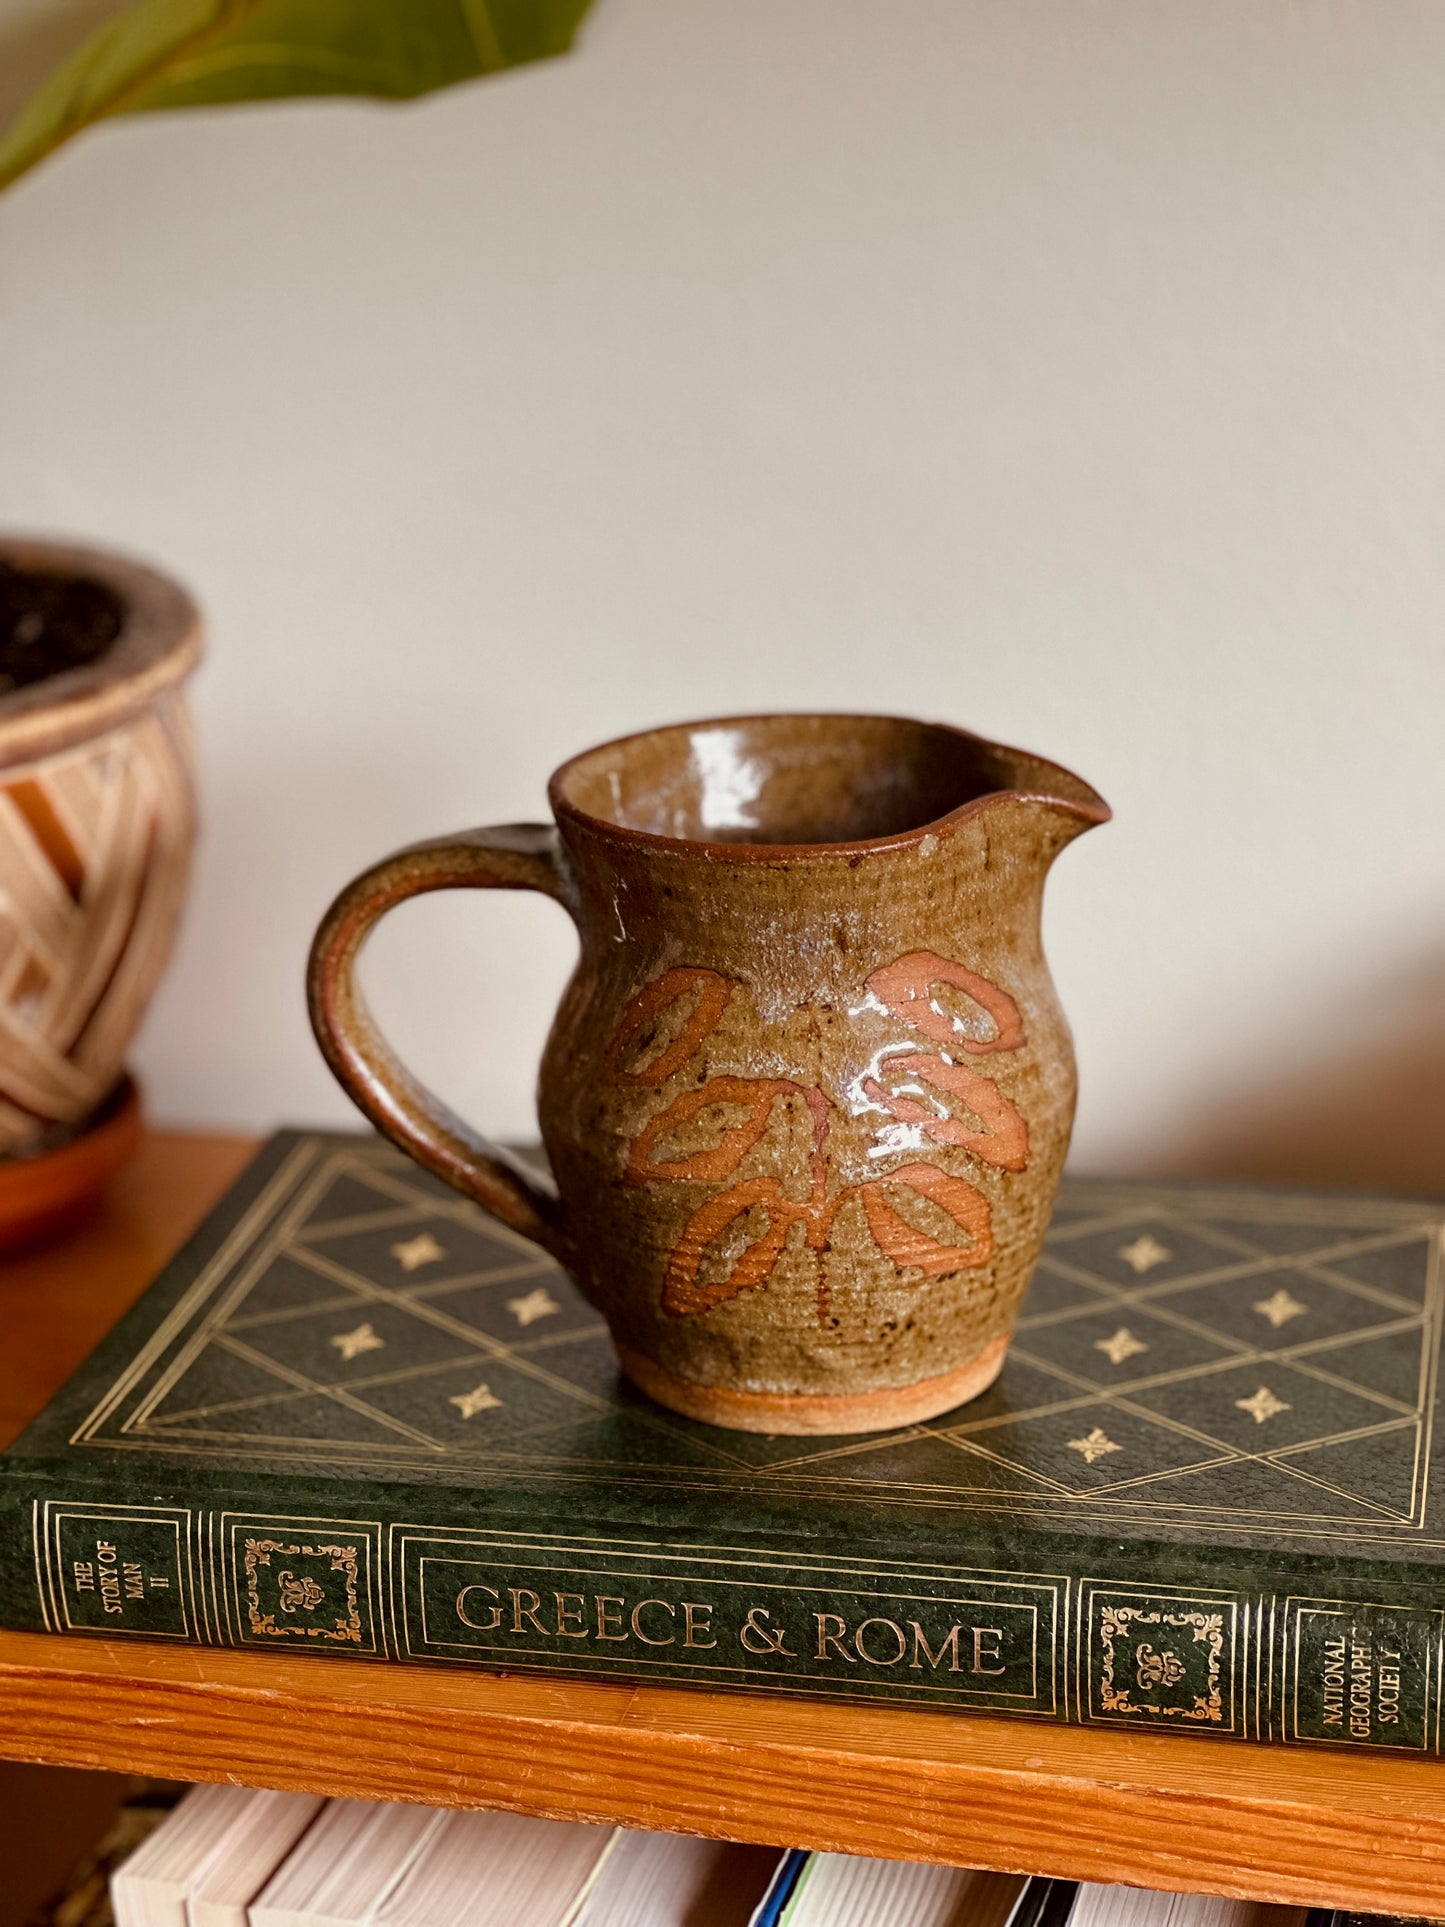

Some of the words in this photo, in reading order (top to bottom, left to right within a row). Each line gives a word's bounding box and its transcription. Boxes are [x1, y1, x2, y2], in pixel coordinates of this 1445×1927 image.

[97, 1540, 117, 1563] OF
[74, 1561, 95, 1592] THE
[98, 1564, 123, 1614] STORY
[123, 1562, 145, 1599] MAN
[150, 1576, 169, 1588] II
[456, 1584, 718, 1649] GREECE
[740, 1607, 798, 1657] &
[812, 1612, 1006, 1675] ROME
[1322, 1635, 1346, 1726] NATIONAL
[1377, 1646, 1401, 1724] SOCIETY
